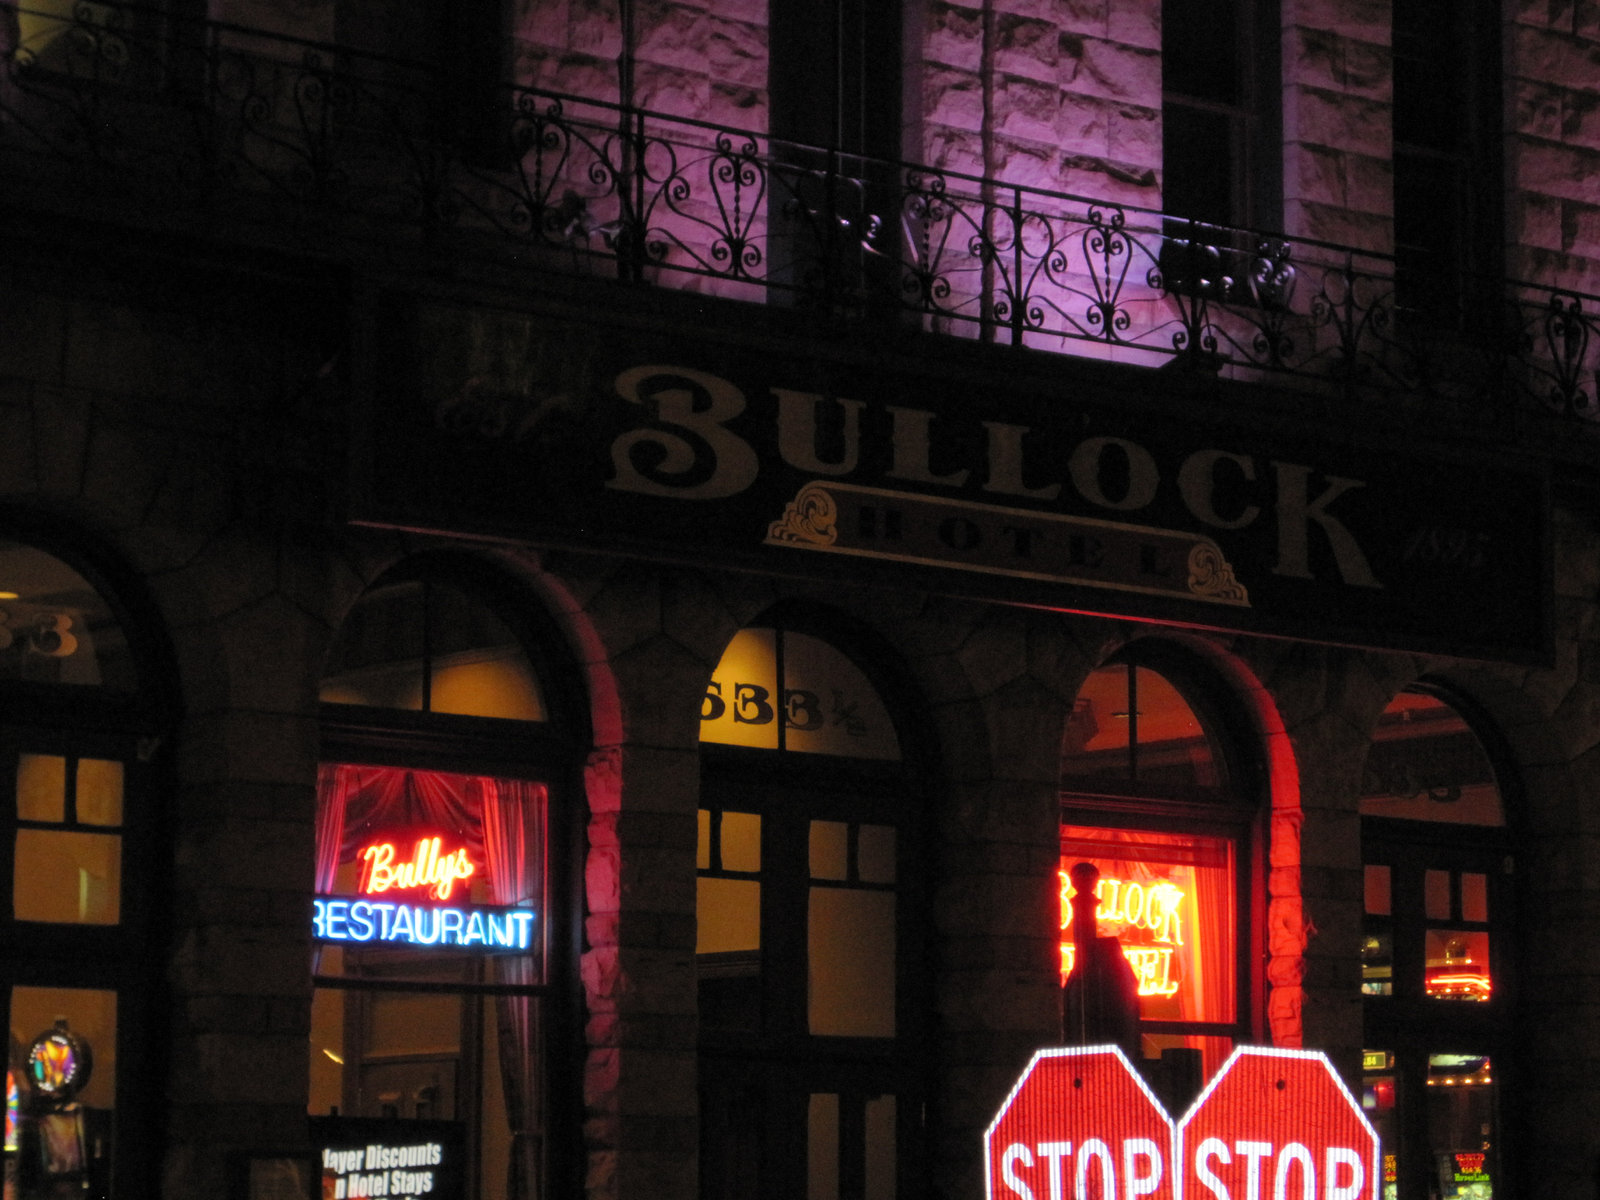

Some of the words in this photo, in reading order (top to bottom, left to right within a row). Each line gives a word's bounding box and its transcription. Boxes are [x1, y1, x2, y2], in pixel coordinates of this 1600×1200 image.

[604, 364, 1383, 590] BULLOCK
[857, 505, 1171, 579] HOTEL
[361, 837, 475, 901] Bullys
[322, 1148, 364, 1175] layer
[366, 1143, 442, 1170] Discounts
[348, 1172, 389, 1198] Hotel
[390, 1170, 433, 1195] Stays
[1001, 1138, 1163, 1200] STOP
[1195, 1137, 1365, 1200] STOP
